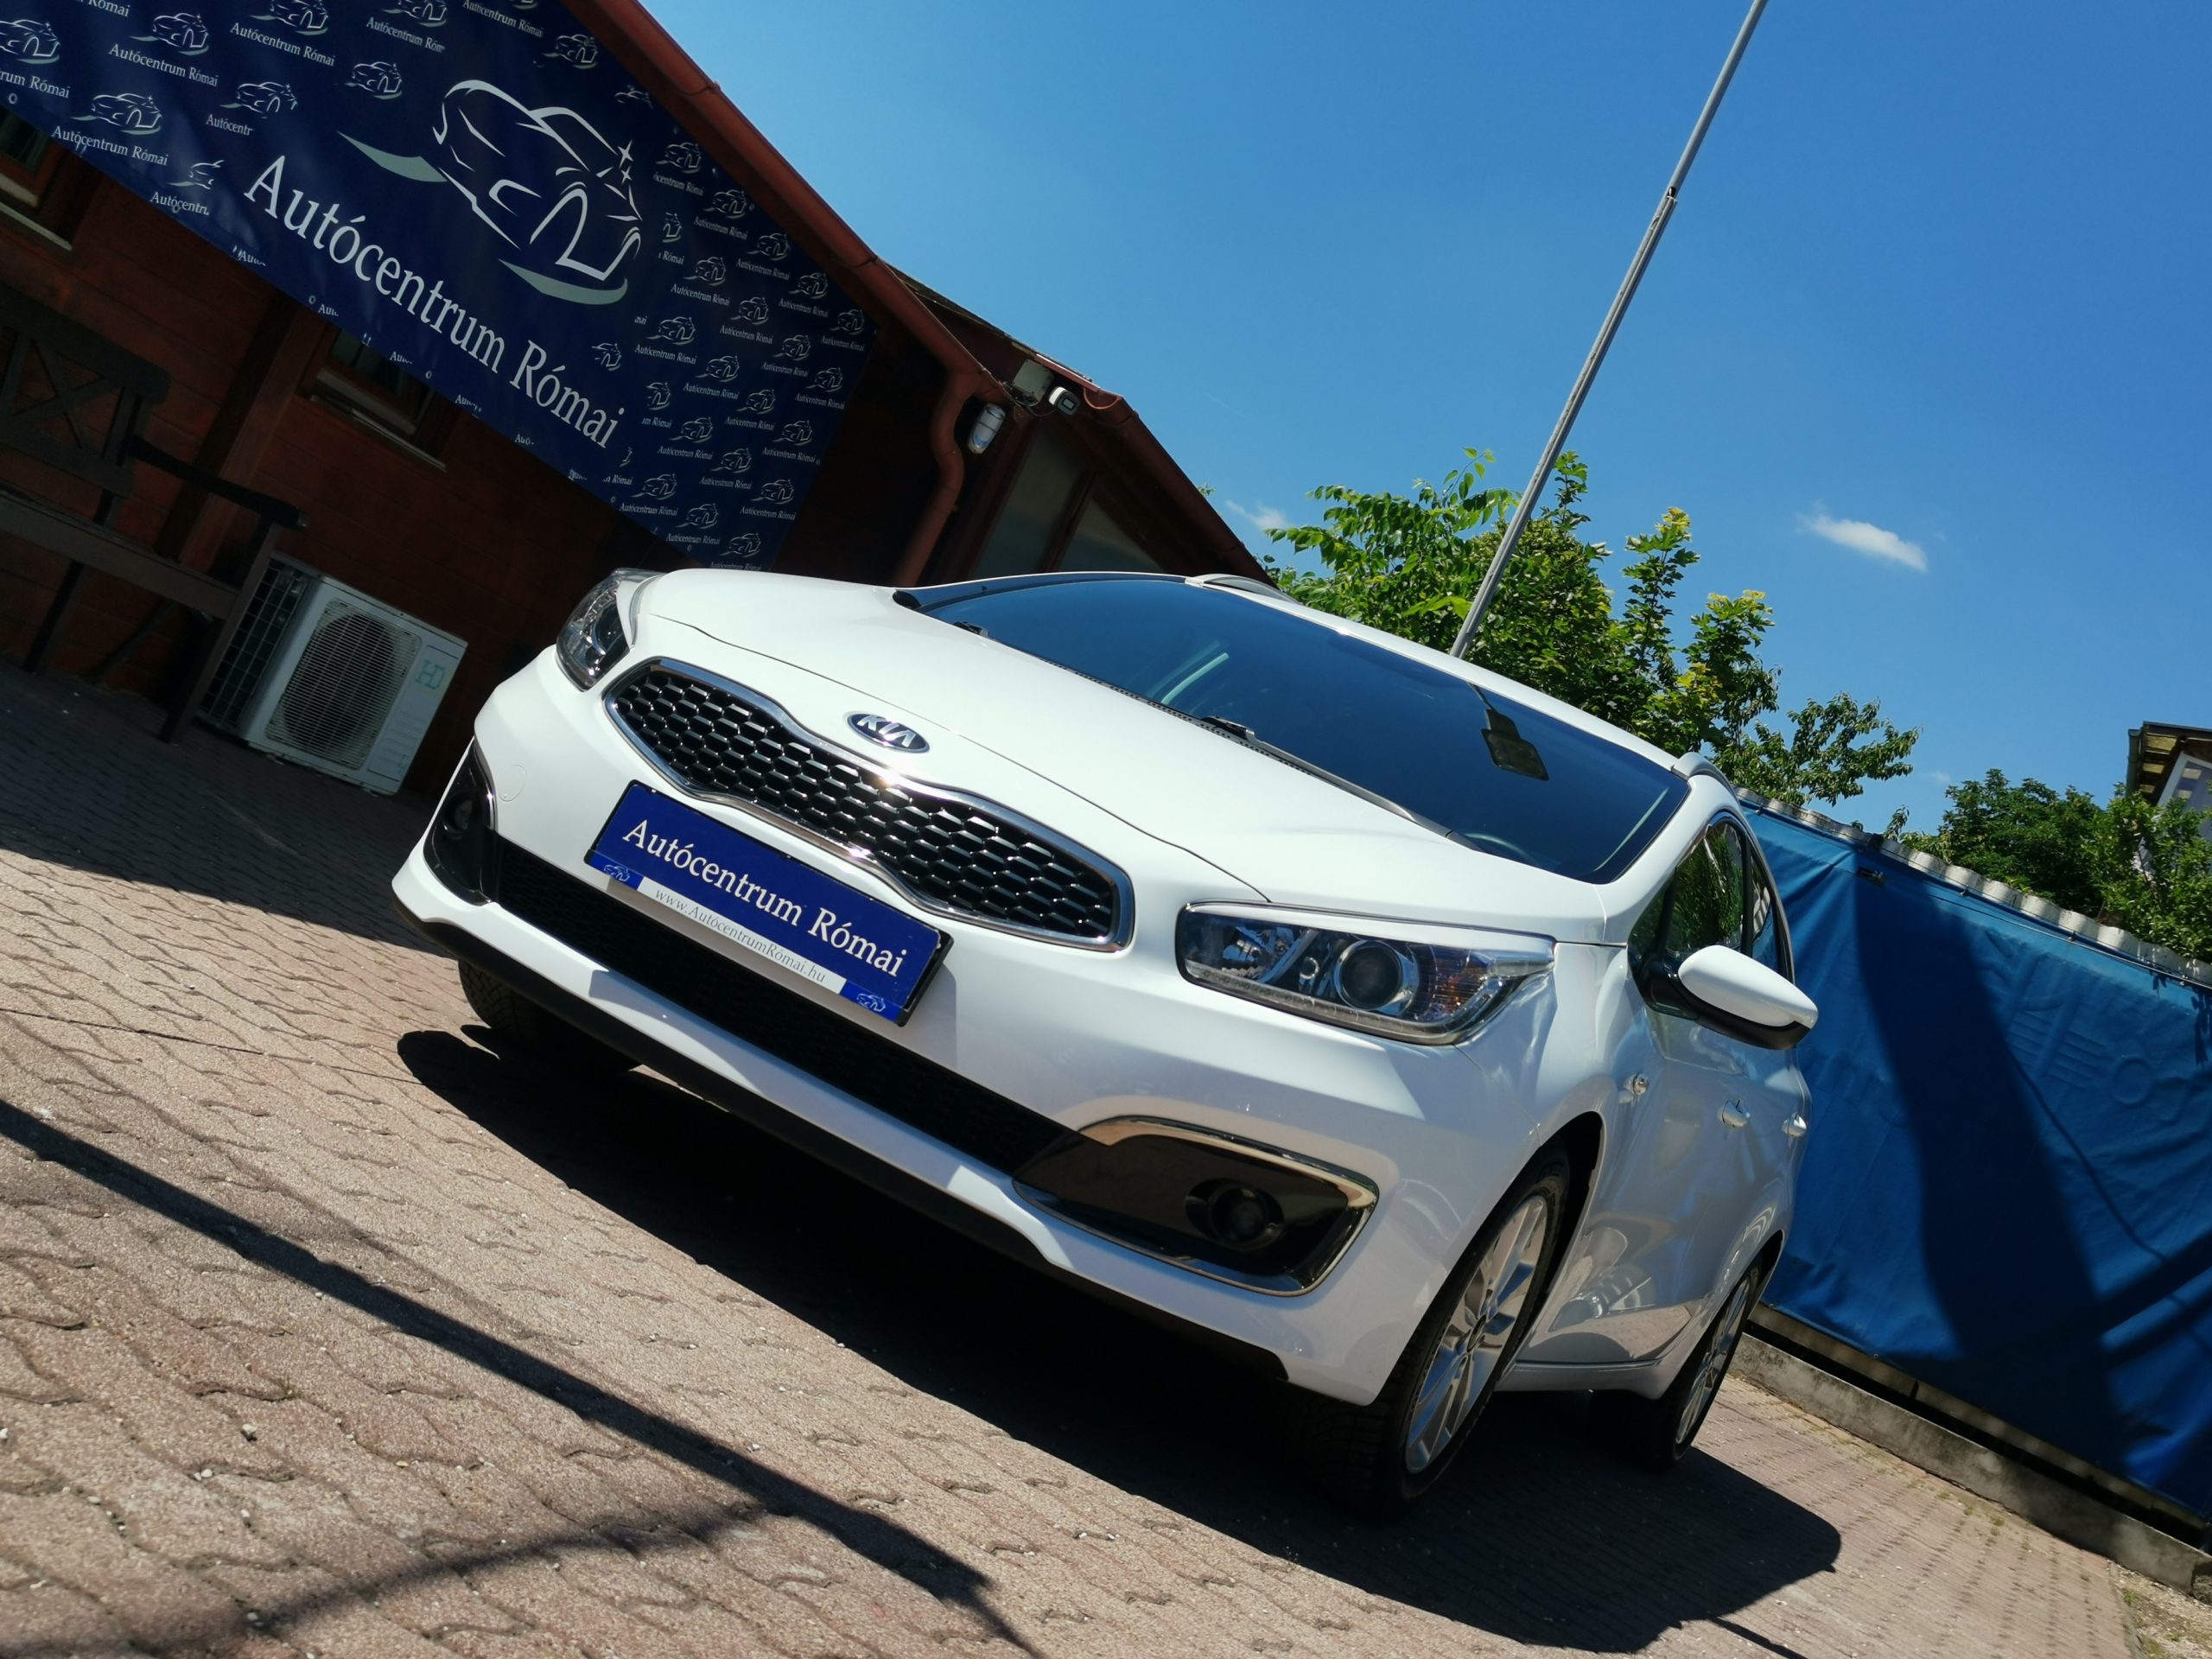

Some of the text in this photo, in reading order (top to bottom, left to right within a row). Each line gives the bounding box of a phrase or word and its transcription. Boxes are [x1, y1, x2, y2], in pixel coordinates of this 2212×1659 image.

[229, 22, 336, 67] Autócentrum Római
[366, 16, 423, 47] Autócentrum
[108, 43, 219, 87] Autócentrum Római
[29, 75, 71, 99] Római
[51, 125, 169, 166] Autócentrum Római
[663, 250, 685, 264] Római
[243, 154, 625, 449] Autócentrum Római
[857, 715, 918, 747] KIA
[622, 819, 908, 978] Autócentrum Római
[655, 887, 826, 983] www.AutócentrumRómai.hu
